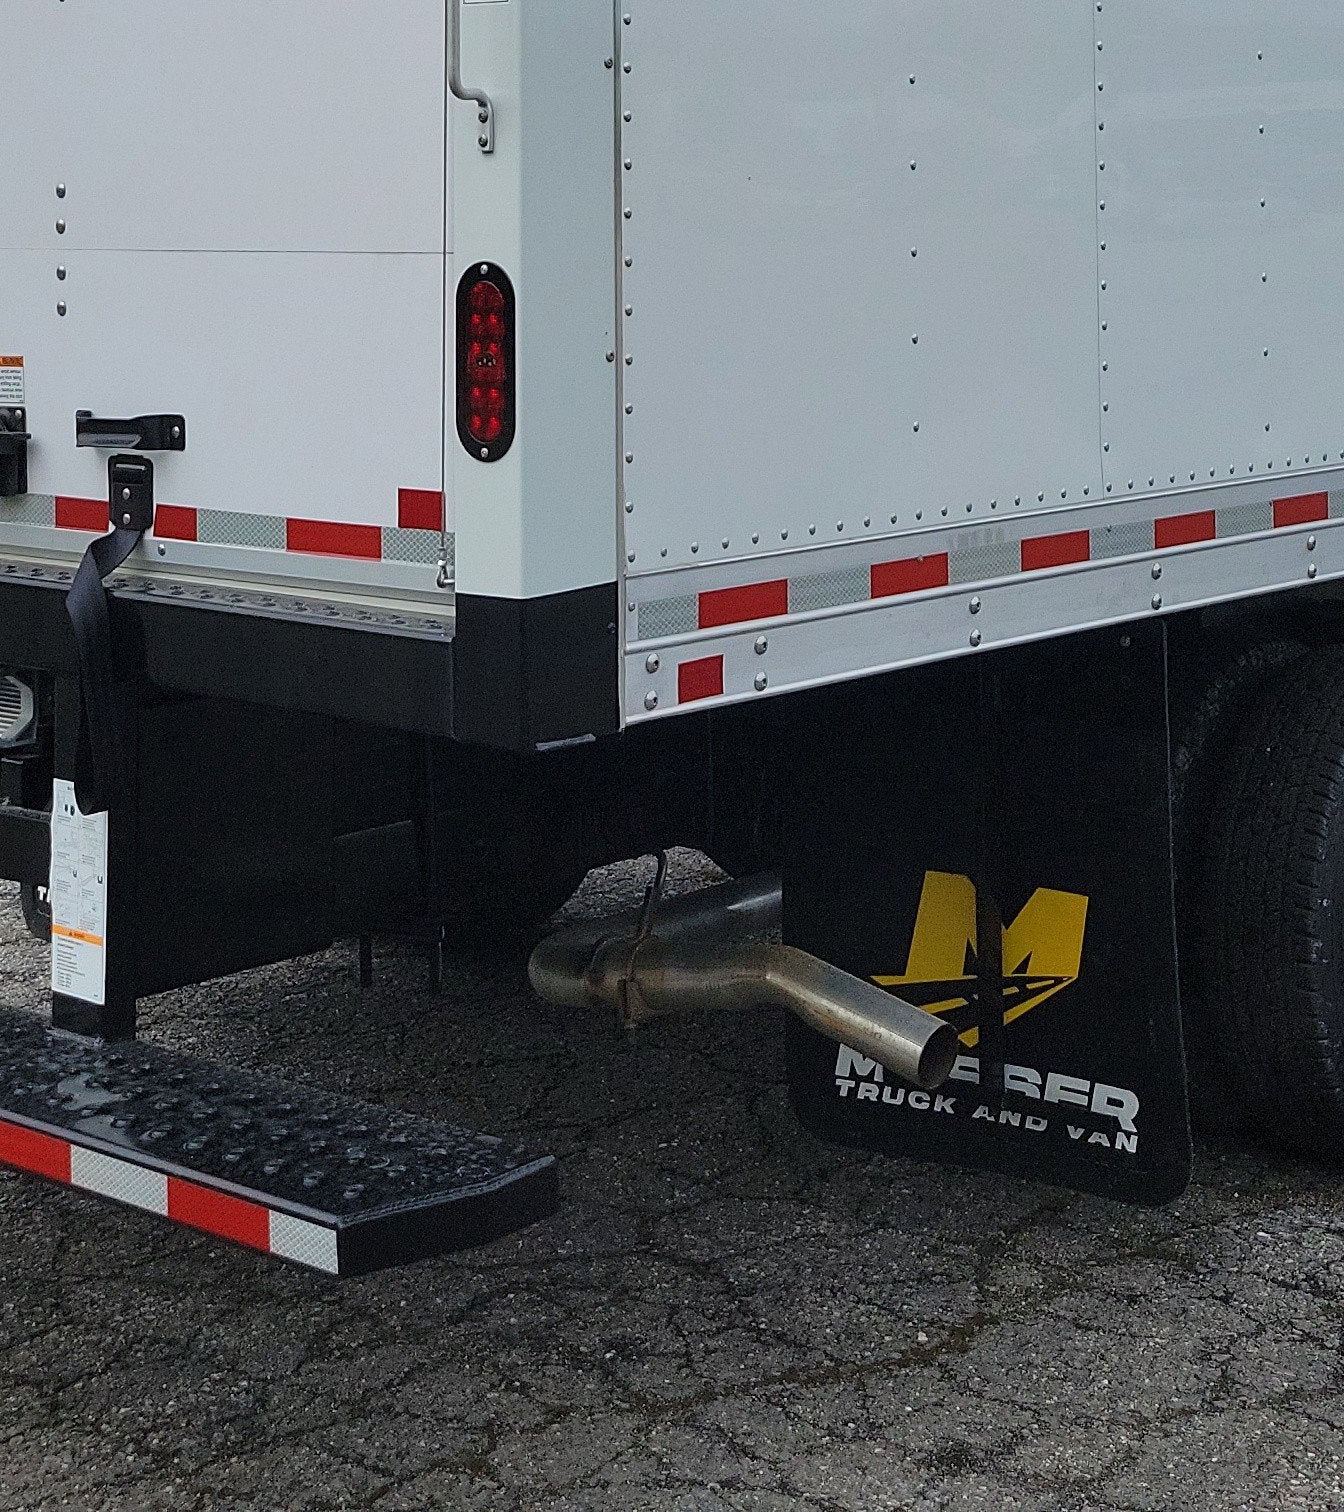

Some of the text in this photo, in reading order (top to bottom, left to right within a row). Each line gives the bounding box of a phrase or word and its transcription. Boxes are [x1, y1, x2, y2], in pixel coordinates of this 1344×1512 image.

[834, 1042, 1141, 1133] MSER
[834, 1077, 1140, 1154] TRUCK AND VAN
